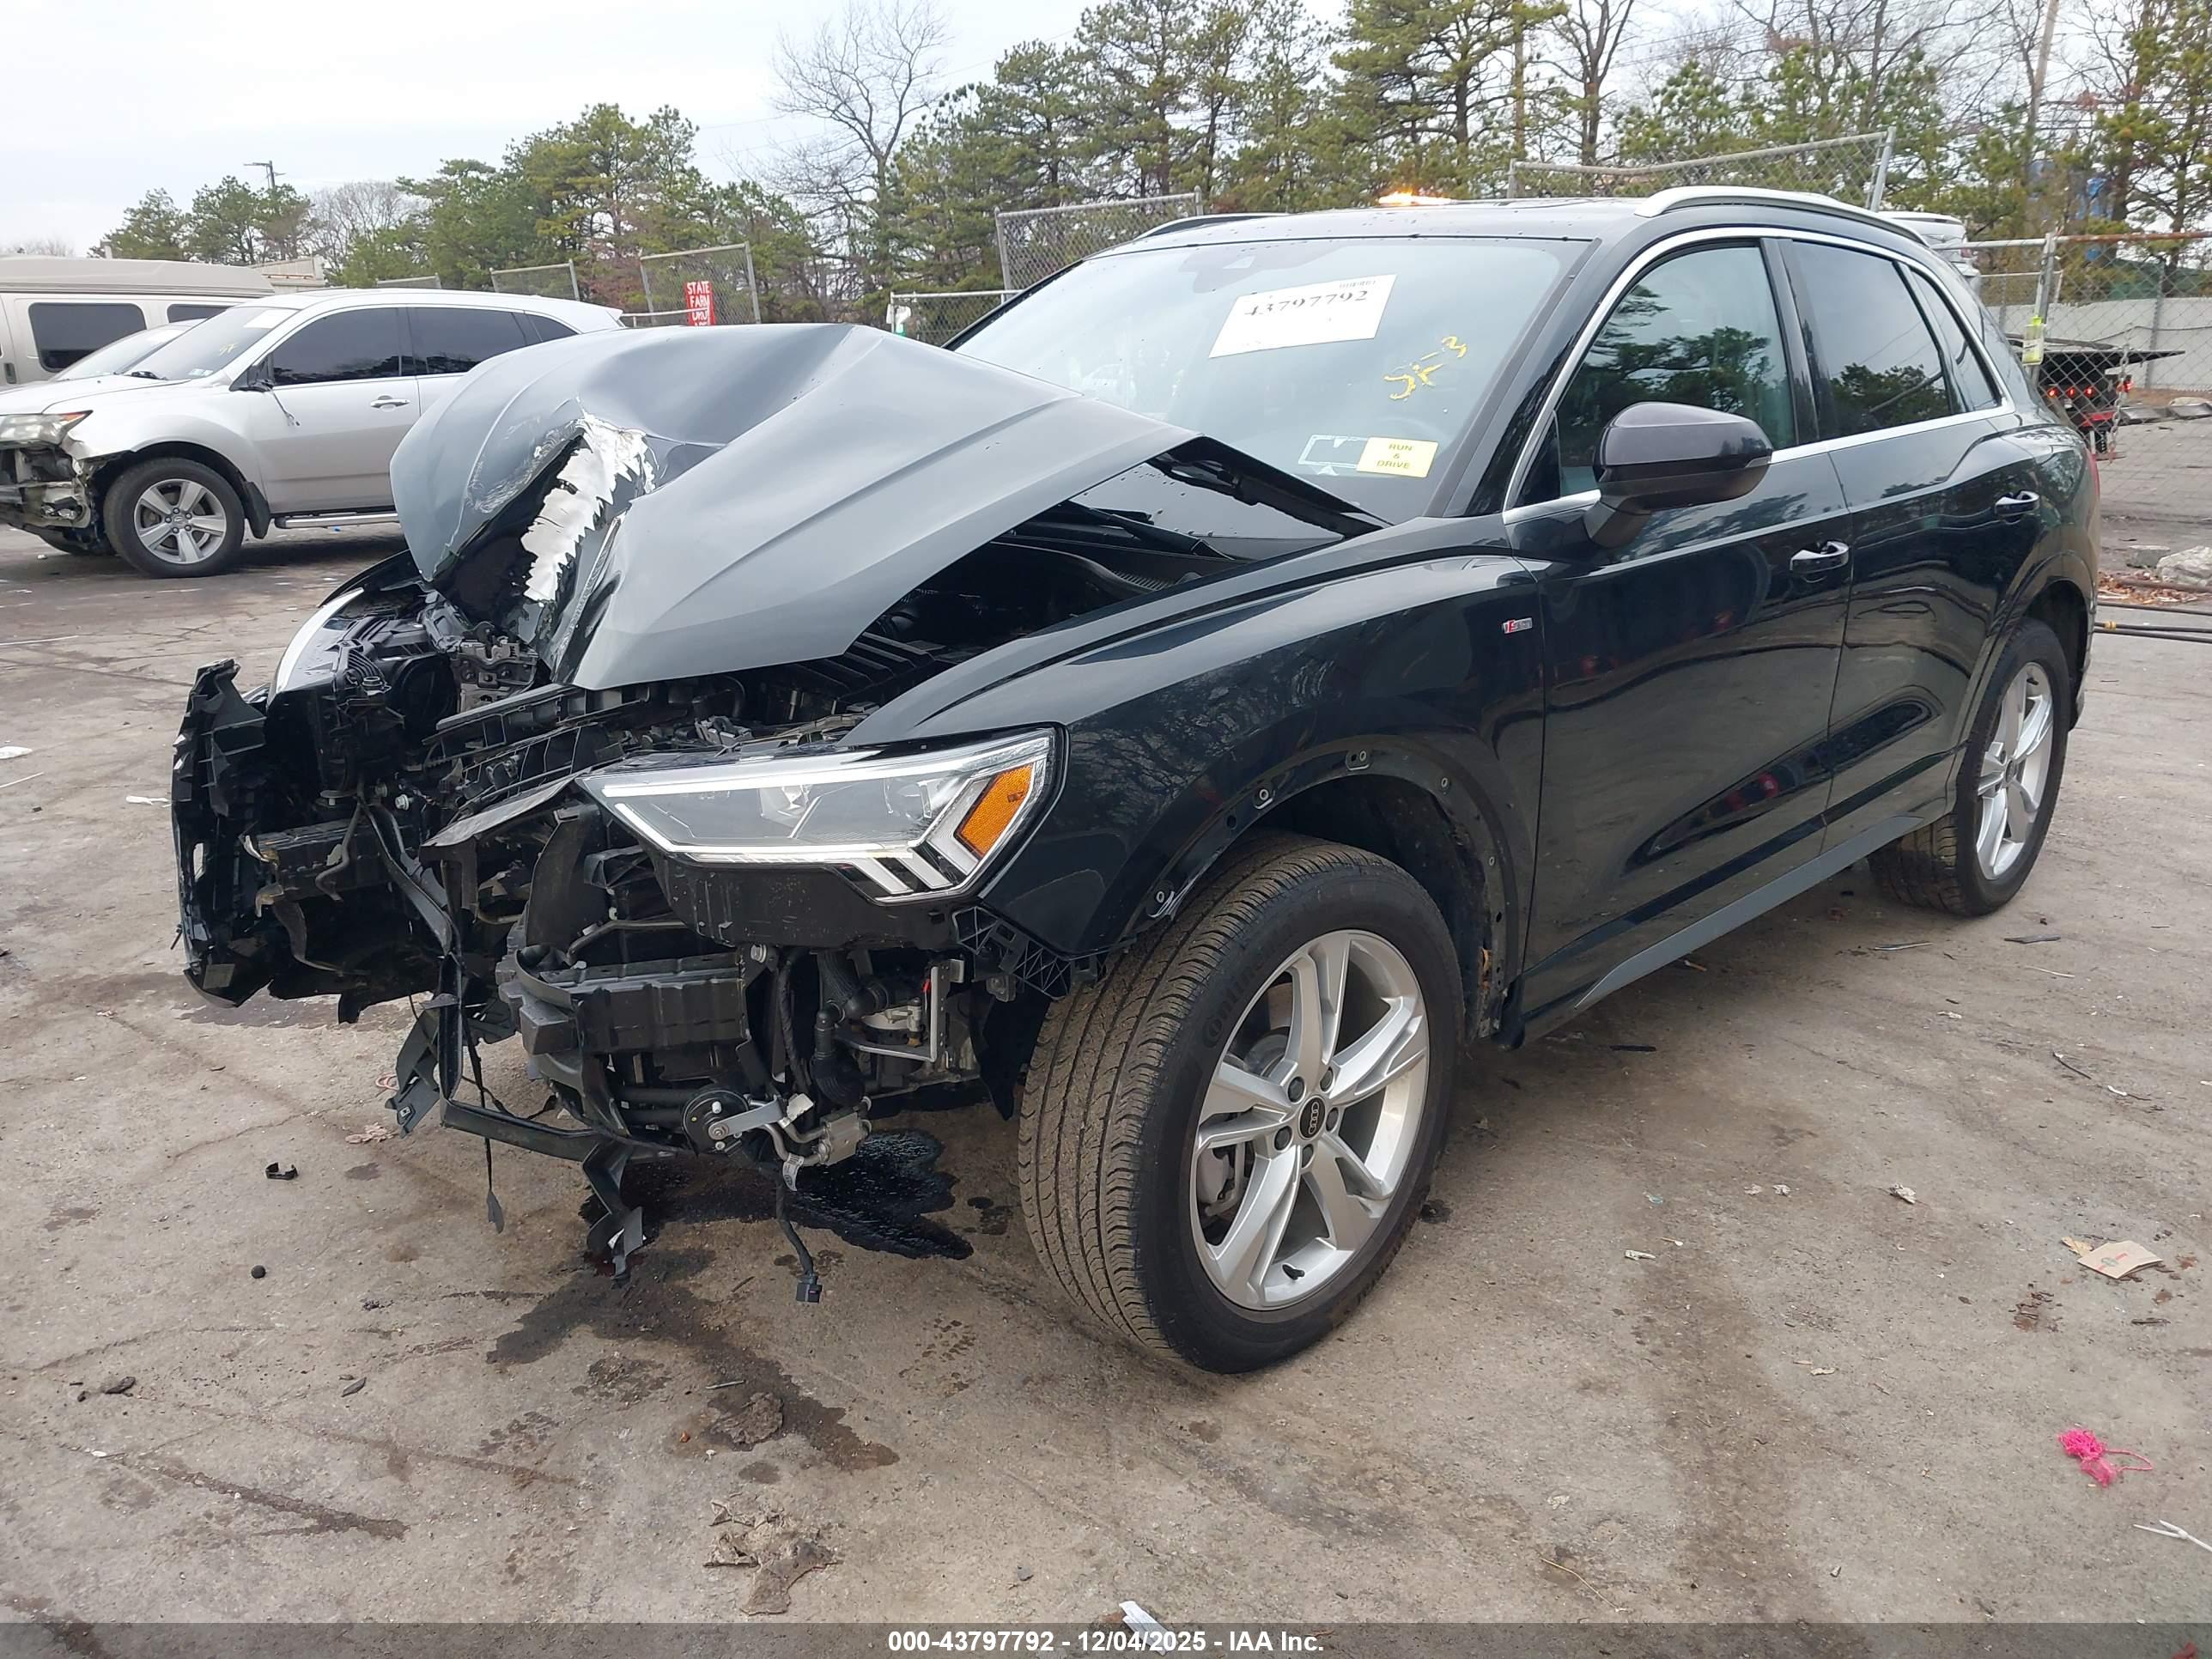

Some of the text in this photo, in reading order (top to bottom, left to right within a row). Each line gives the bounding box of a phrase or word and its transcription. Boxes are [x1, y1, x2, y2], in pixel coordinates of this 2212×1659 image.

[686, 281, 710, 295] STATE
[690, 294, 710, 308] FARM
[1244, 290, 1368, 316] 43797792
[1441, 335, 1468, 358] 3
[1388, 442, 1414, 452] RUN
[1376, 459, 1412, 469] DRIVE
